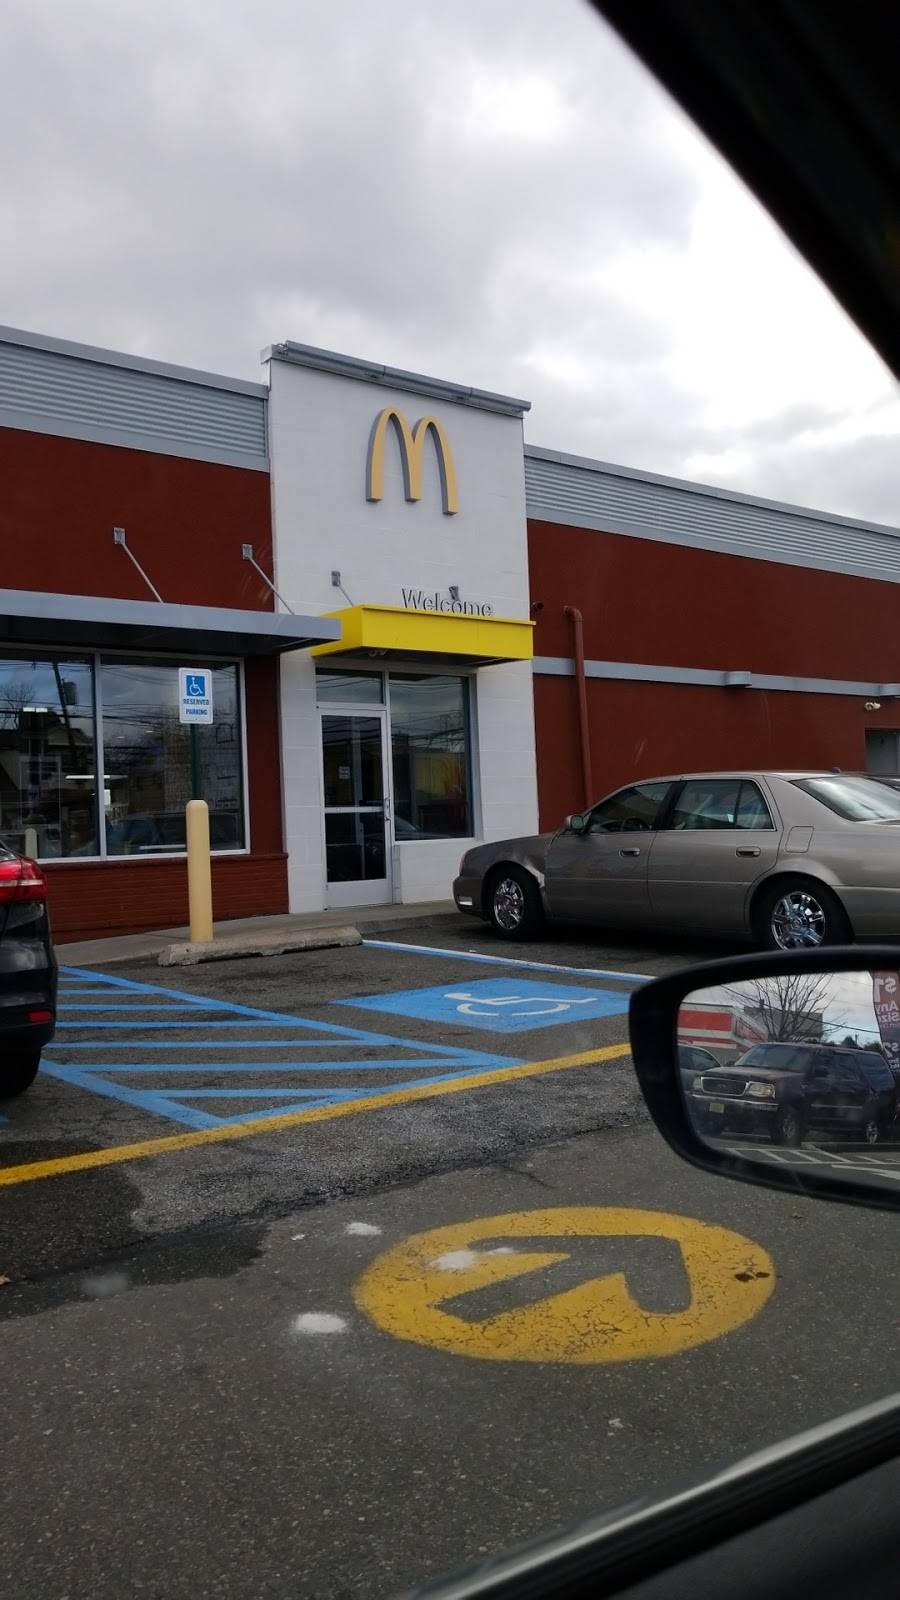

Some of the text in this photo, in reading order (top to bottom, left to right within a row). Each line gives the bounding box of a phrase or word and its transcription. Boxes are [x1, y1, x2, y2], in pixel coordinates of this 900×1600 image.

[366, 405, 459, 515] M
[401, 587, 493, 616] Welcome
[186, 708, 208, 716] PARKING
